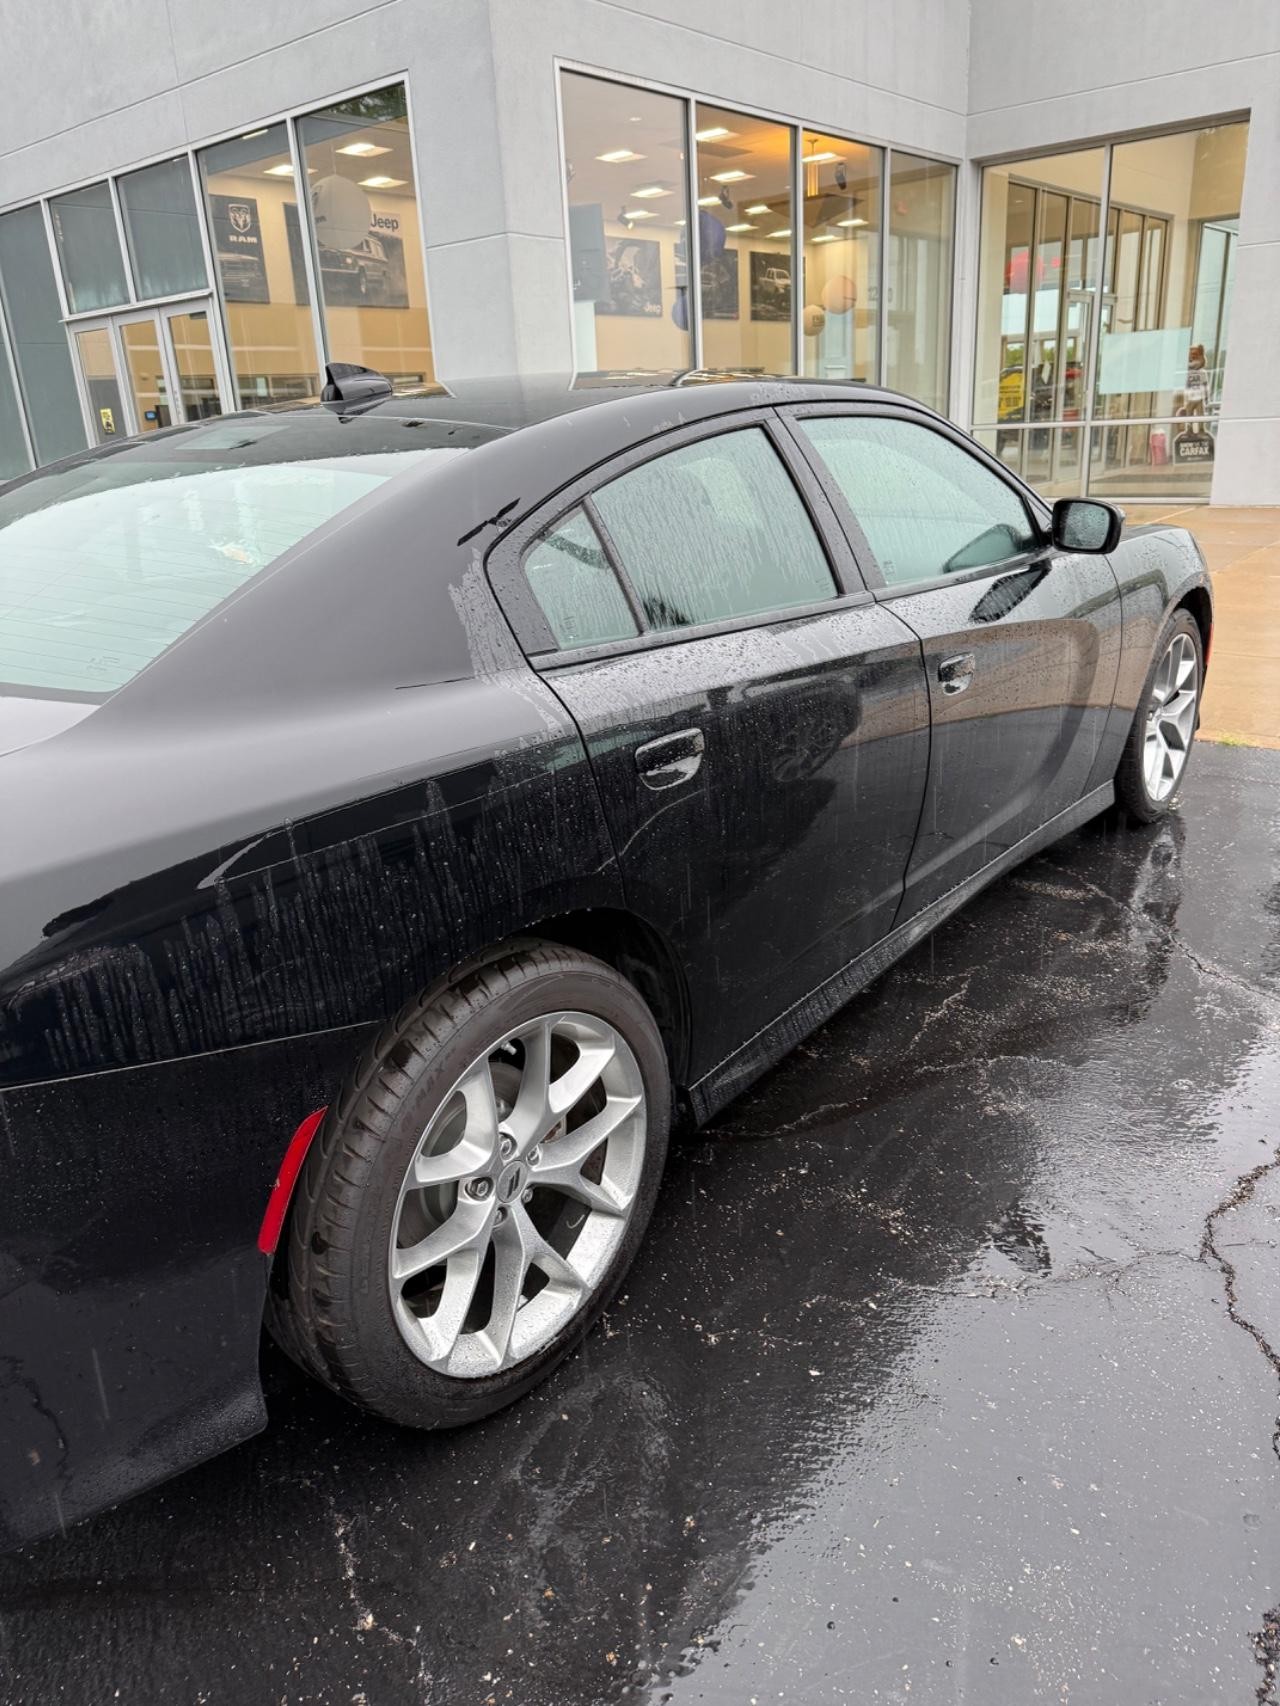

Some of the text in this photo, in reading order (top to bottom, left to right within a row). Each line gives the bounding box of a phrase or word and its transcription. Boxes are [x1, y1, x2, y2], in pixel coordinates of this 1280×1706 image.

[370, 213, 399, 232] Jeep
[229, 235, 258, 244] RAM
[1179, 446, 1209, 457] CARFAX
